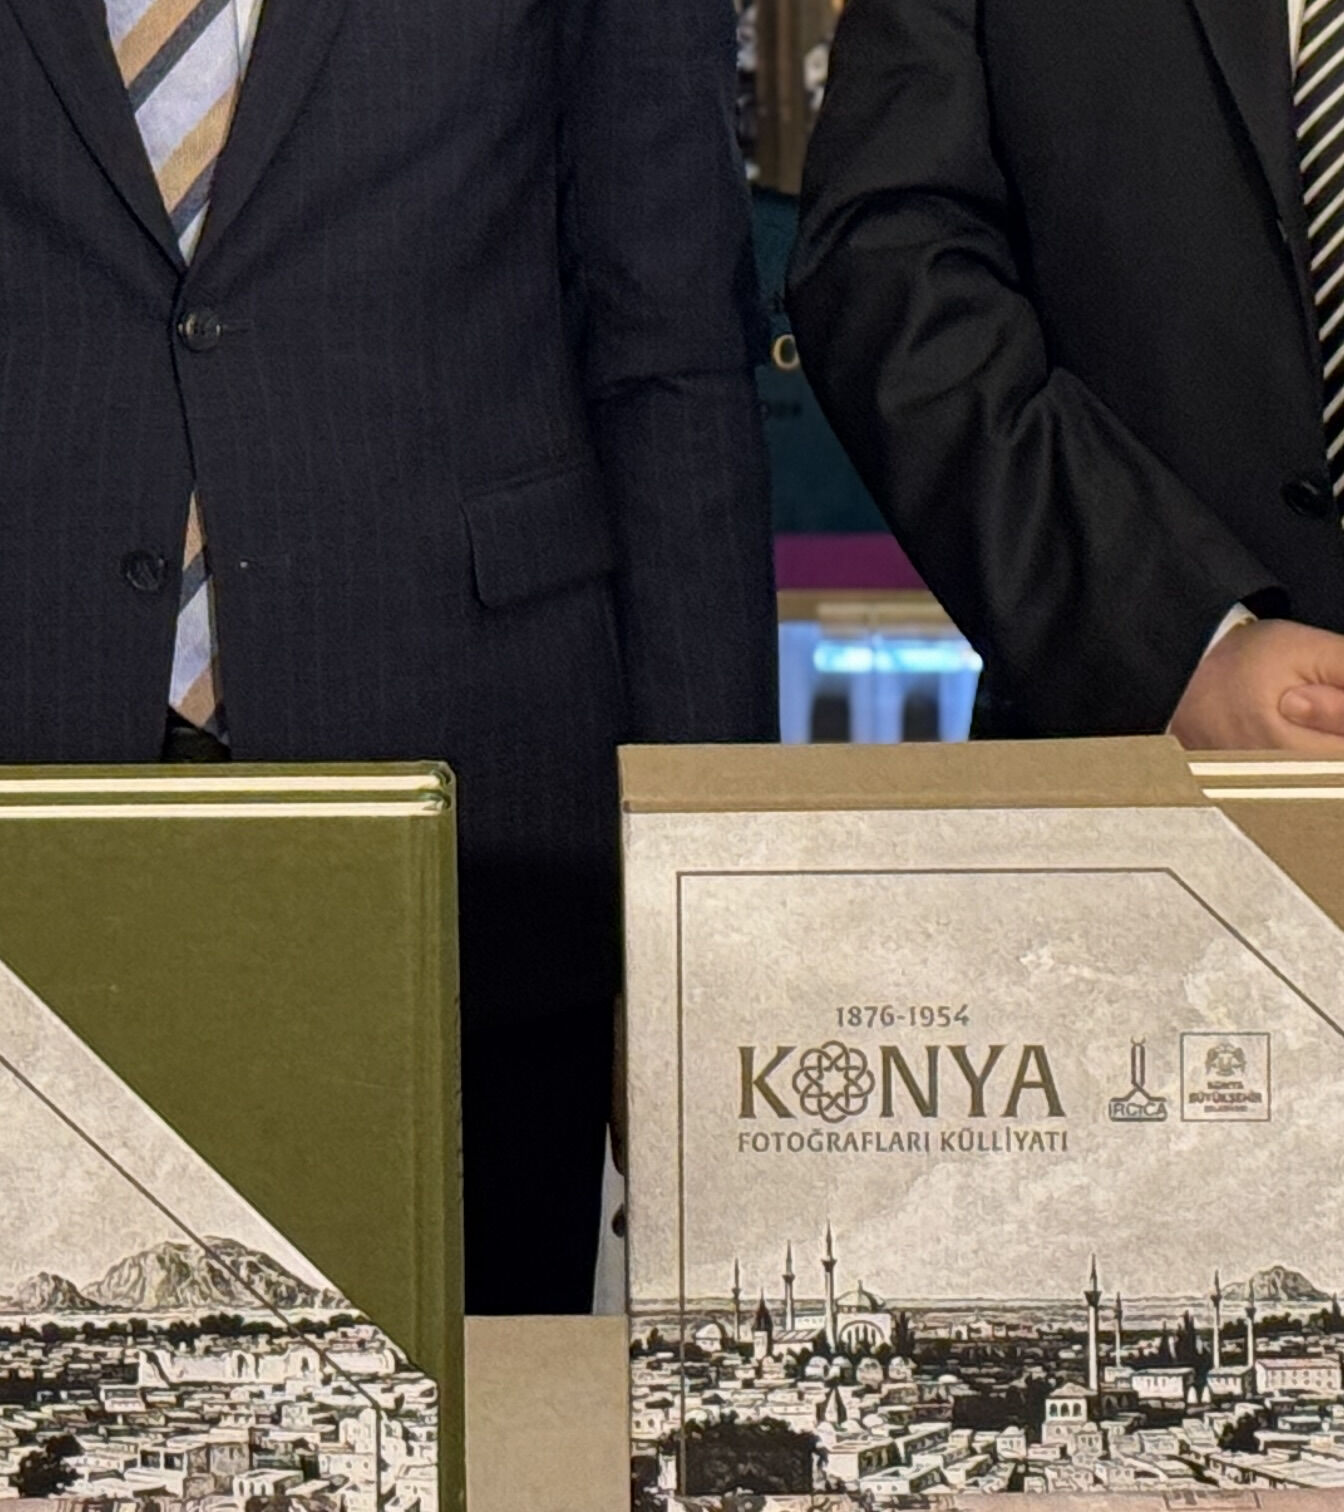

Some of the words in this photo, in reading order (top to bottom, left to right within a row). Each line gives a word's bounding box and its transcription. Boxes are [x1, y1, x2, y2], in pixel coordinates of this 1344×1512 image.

[836, 1002, 971, 1029] 1876-1954
[738, 1039, 1067, 1124] KONYA
[738, 1126, 931, 1154] FOTOĞRAFLARI
[939, 1125, 1069, 1154] KÜLLİYATI
